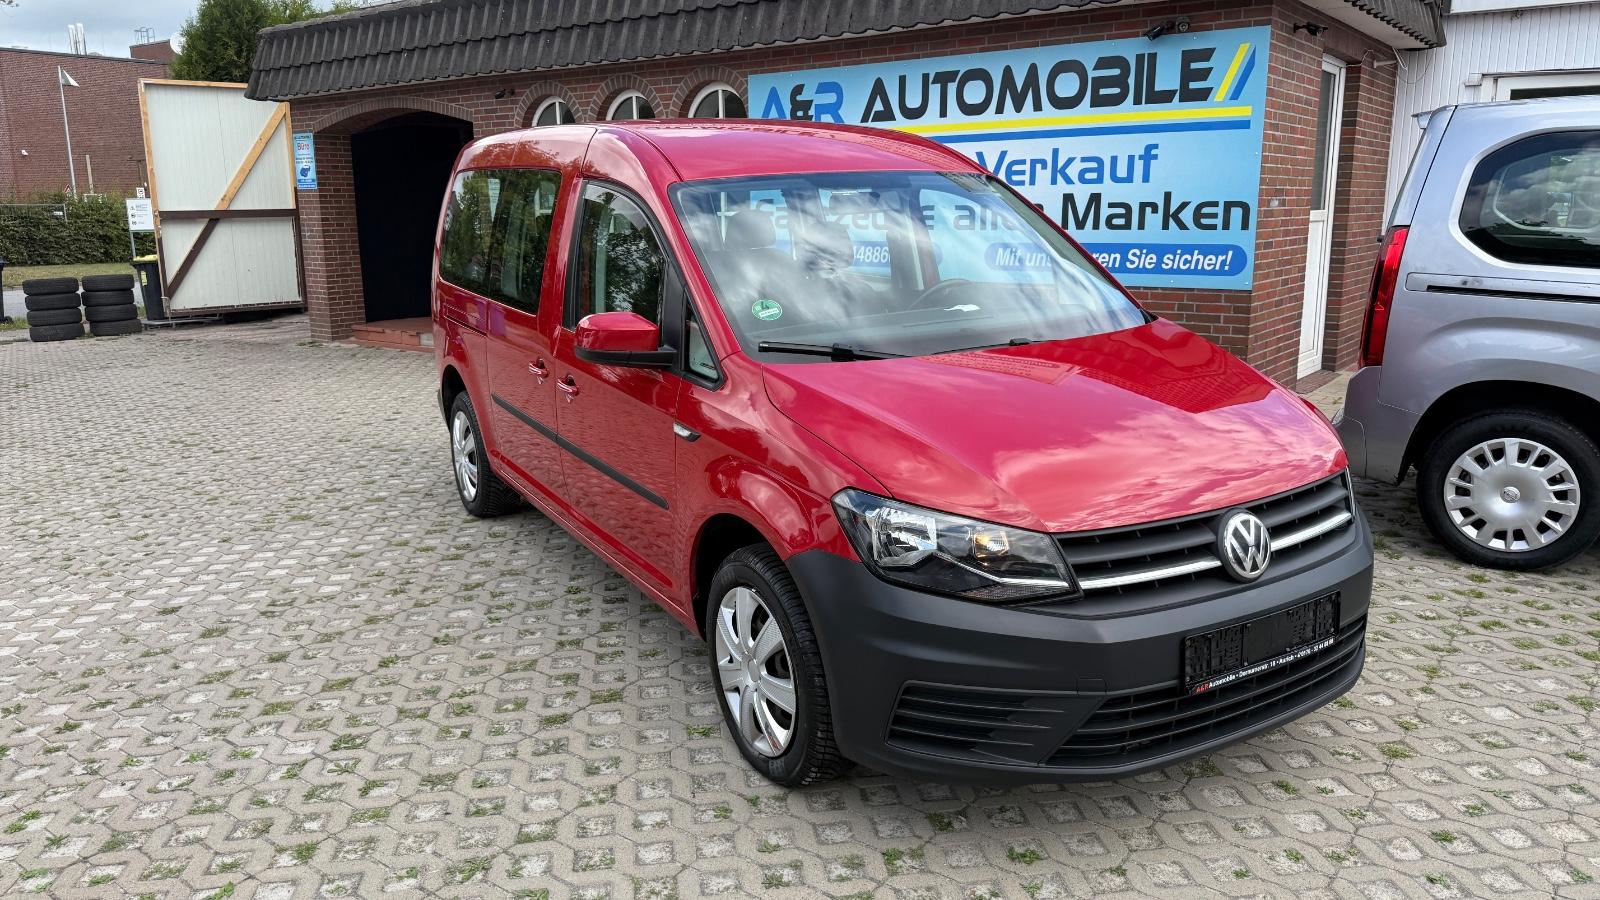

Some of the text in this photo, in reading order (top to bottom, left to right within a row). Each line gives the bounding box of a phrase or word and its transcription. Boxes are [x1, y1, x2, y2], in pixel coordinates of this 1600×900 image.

[761, 47, 1217, 124] A&R AUTOMOBILE
[975, 143, 1159, 187] Verkauf
[1061, 191, 1250, 231] Marken
[994, 247, 1022, 267] Mit
[1126, 248, 1157, 269] Sie
[1161, 249, 1234, 270] sicher!
